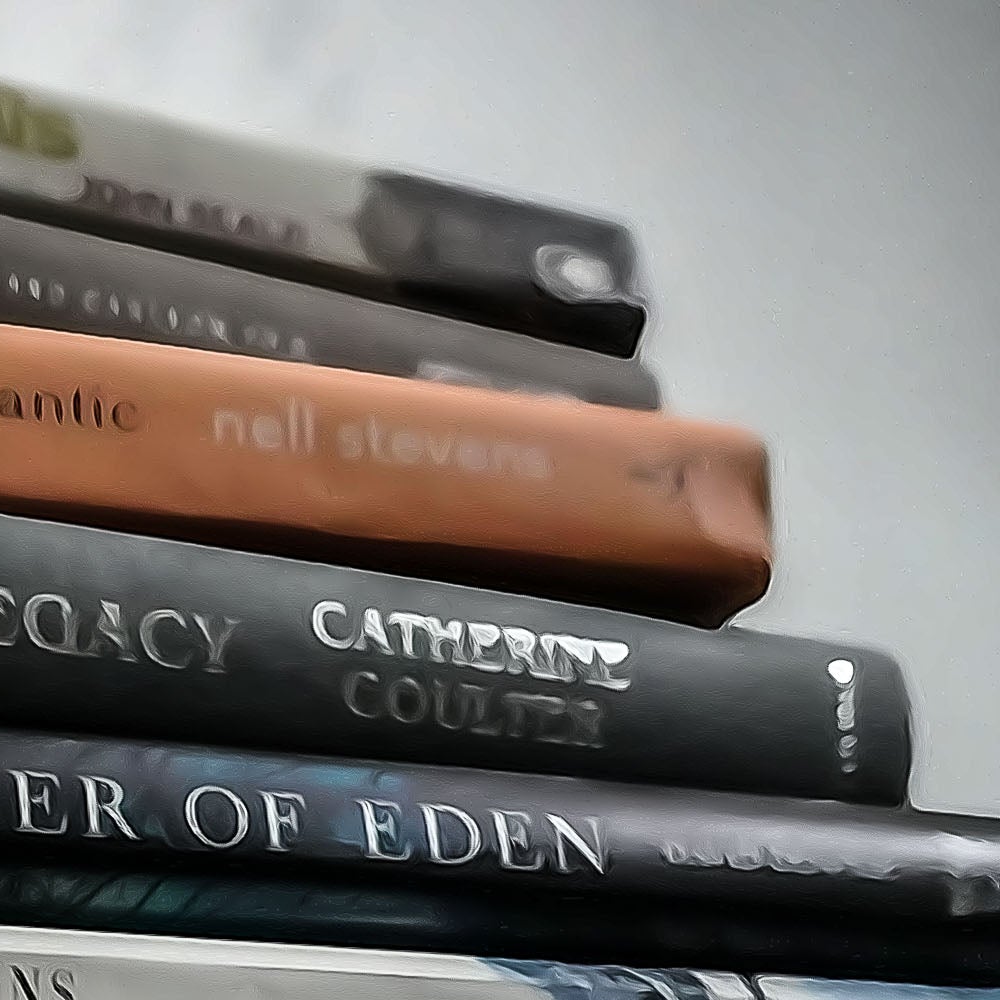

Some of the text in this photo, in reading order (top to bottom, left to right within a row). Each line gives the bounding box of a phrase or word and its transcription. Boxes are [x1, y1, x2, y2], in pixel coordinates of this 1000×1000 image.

[212, 398, 317, 455] nell
[336, 408, 551, 481] stevens
[311, 600, 633, 691] CATHERINE
[183, 785, 306, 853] OF
[354, 798, 609, 876] EDEN
